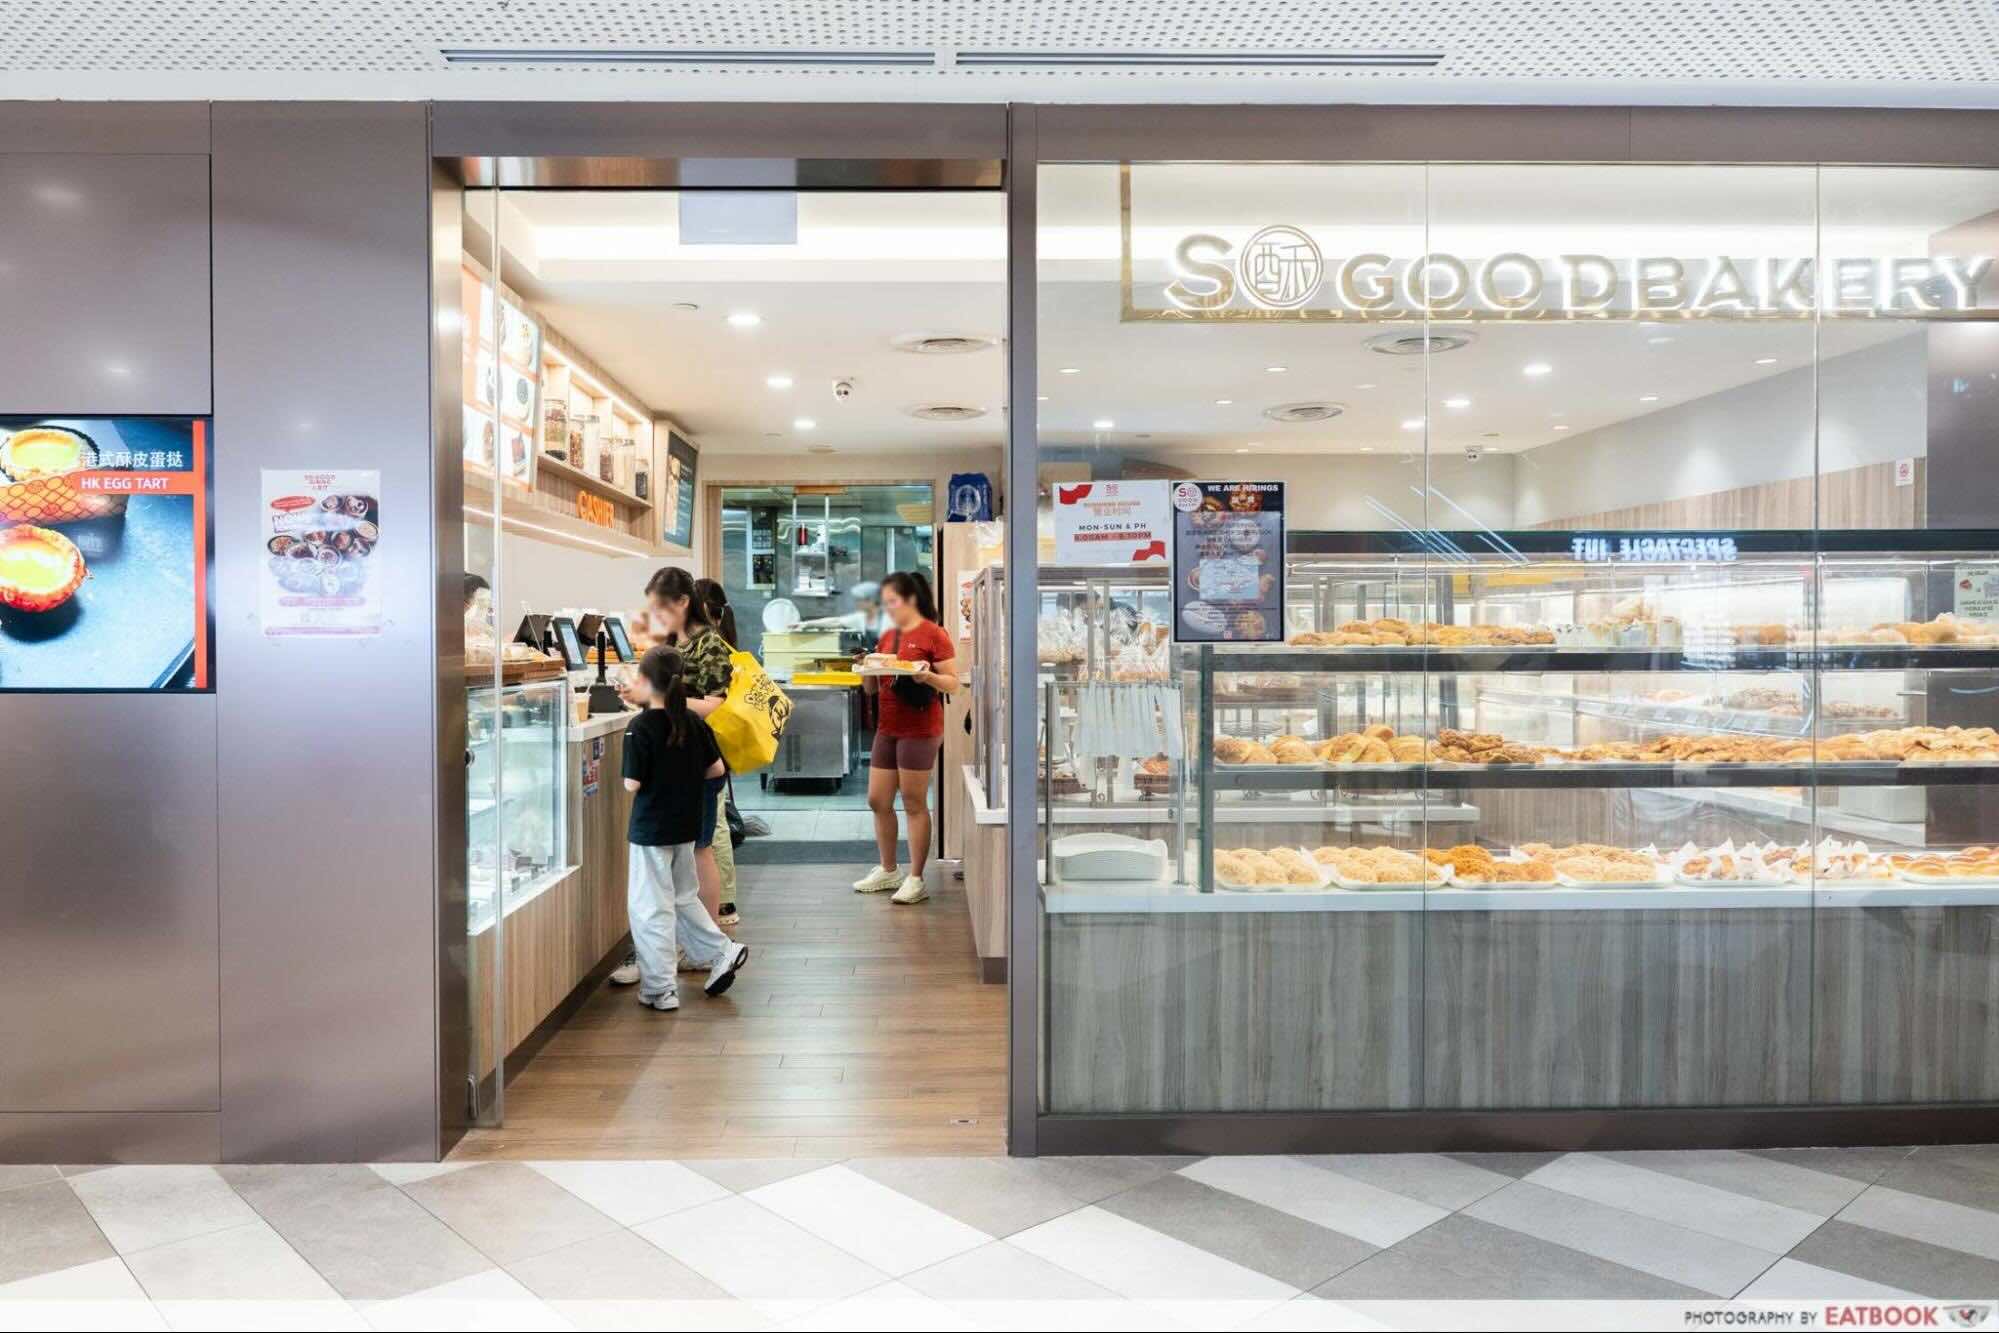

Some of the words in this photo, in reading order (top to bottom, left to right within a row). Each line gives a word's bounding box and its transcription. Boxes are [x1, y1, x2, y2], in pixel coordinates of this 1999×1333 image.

[81, 478, 100, 489] HK
[104, 478, 132, 489] EGG
[135, 478, 169, 489] TART
[1207, 484, 1222, 492] WE
[577, 491, 615, 528] CASHIER
[1078, 523, 1122, 531] MON-SUN
[1134, 522, 1147, 530] PH
